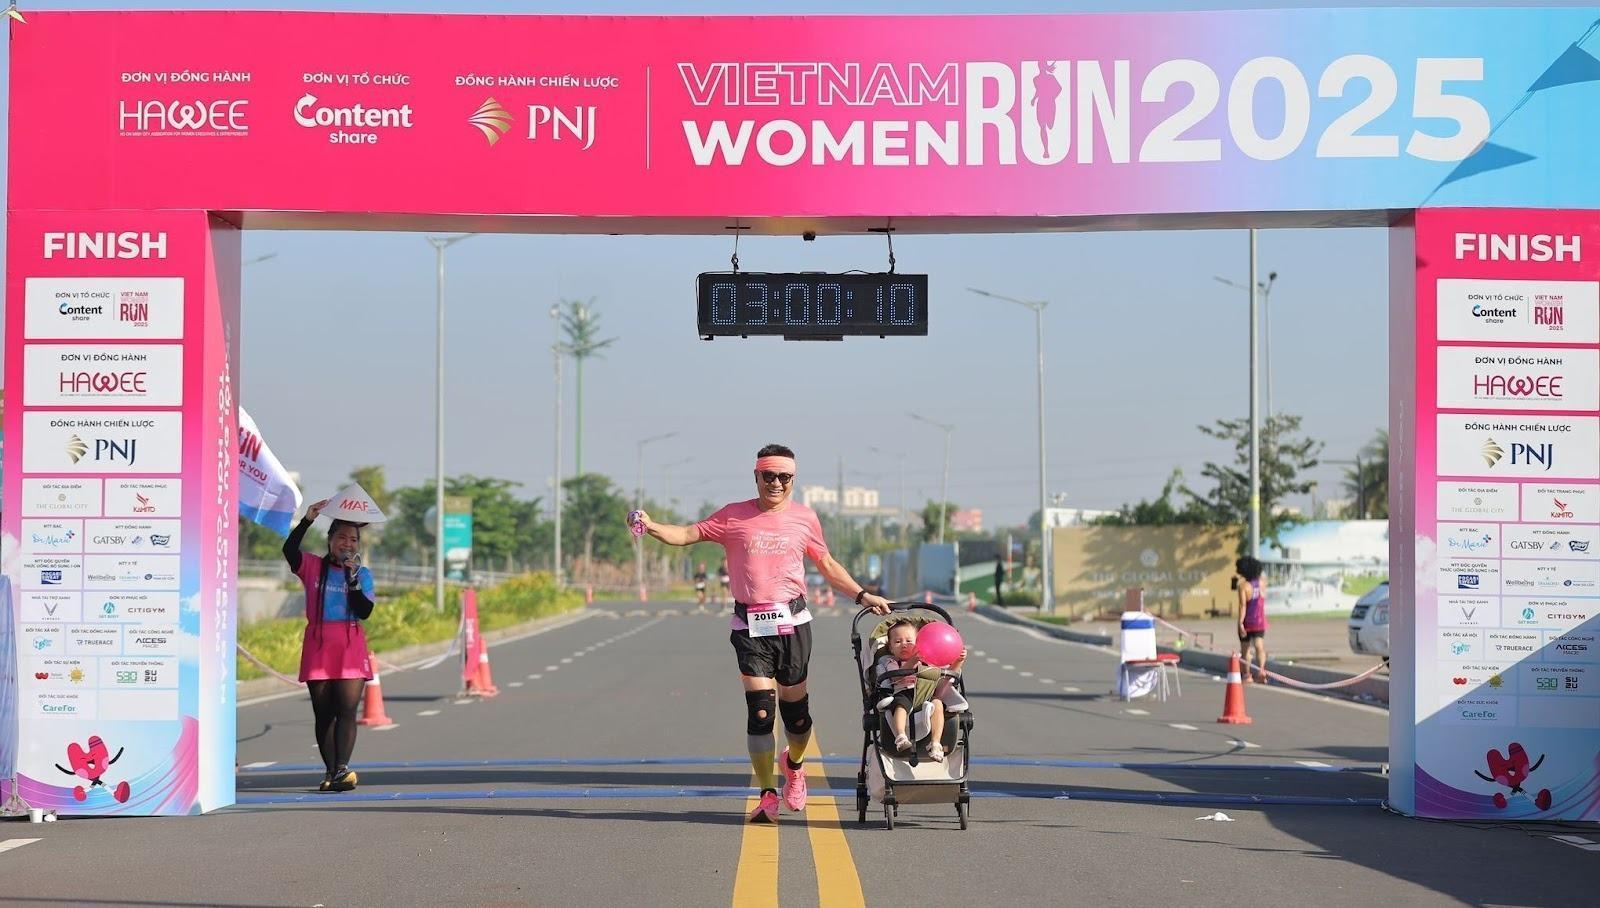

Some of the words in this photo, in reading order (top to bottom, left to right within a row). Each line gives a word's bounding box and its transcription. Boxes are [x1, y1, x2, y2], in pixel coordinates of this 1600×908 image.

[121, 72, 151, 82] ĐƠN
[155, 73, 167, 84] VỊ
[170, 70, 210, 82] ĐỒNG
[213, 70, 250, 82] HÀNH
[302, 72, 332, 83] ĐƠN
[336, 74, 349, 86] VỊ
[352, 71, 370, 84] TỔ
[373, 73, 410, 85] CHỨC
[455, 73, 494, 86] ĐỒNG
[498, 74, 536, 86] HÀNH
[540, 74, 580, 87] CHIẾN
[584, 76, 619, 90] LƯỢC
[678, 62, 958, 106] VIETNAM
[120, 100, 248, 130] HAWEE
[294, 92, 414, 128] Content
[965, 60, 1130, 166] RUN
[1138, 54, 1491, 162] 2025
[526, 104, 597, 150] PNJ
[329, 130, 378, 144] share
[681, 119, 959, 166] WOMEN
[44, 232, 166, 258] FINISH
[1456, 233, 1580, 262] FINISH
[59, 302, 102, 315] Content
[120, 304, 148, 321] RUN
[712, 284, 914, 325] 03:00:10
[1472, 304, 1516, 317] Content
[1535, 306, 1563, 324] RUN
[94, 352, 119, 361] ĐỒNG
[122, 353, 147, 361] HÀNH
[1475, 356, 1495, 364] ĐƠN
[1498, 358, 1506, 366] VỊ
[1508, 356, 1535, 365] ĐỒNG
[1537, 357, 1562, 365] HÀNH
[60, 372, 147, 392] HAWEE
[1474, 374, 1563, 397] HAWEE
[50, 418, 75, 427] ĐỒNG
[104, 419, 130, 428] CHIẾN
[132, 420, 155, 429] LƯỢC
[1465, 422, 1490, 430] ĐỒNG
[1493, 423, 1517, 431] HÀNH
[1520, 422, 1545, 432] CHIẾN
[1548, 424, 1571, 433] LƯỢC
[95, 439, 136, 466] PNJ
[1511, 443, 1553, 471] PNJ
[249, 465, 268, 481] YOU
[340, 499, 368, 511] MAF
[93, 536, 126, 544] GATSBY
[1511, 541, 1544, 549] GATSBY
[754, 612, 784, 620] 20184
